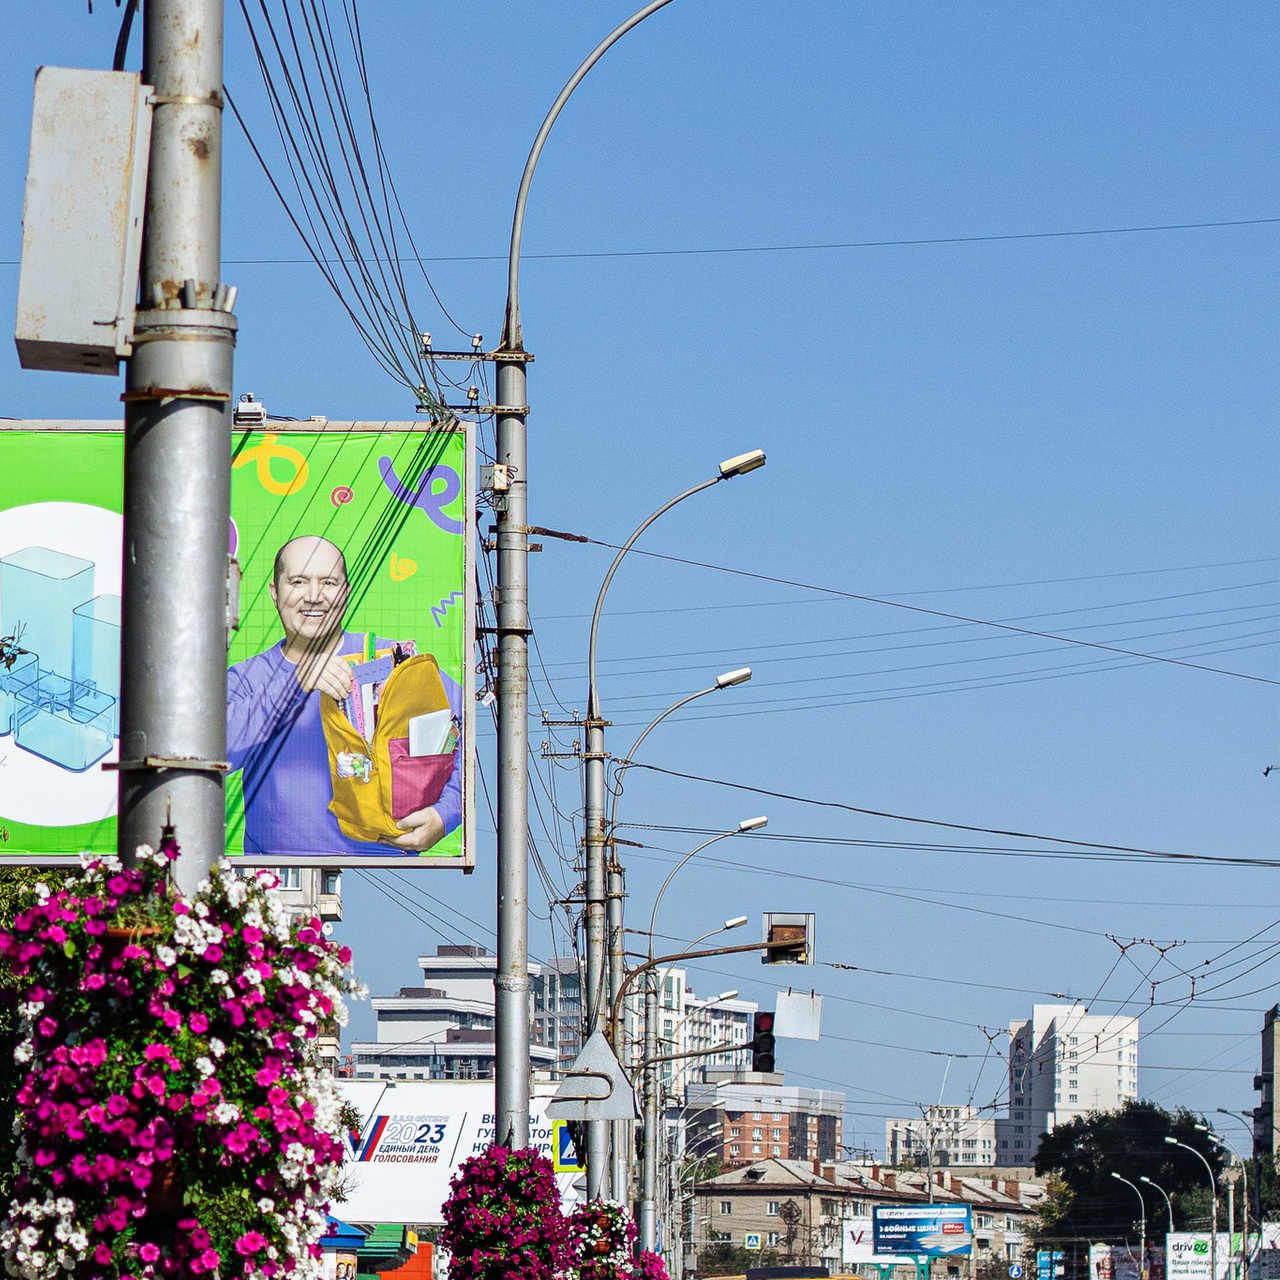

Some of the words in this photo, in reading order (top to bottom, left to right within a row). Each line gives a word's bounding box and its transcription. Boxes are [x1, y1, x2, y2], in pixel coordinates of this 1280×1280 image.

[383, 1122, 447, 1144] 2023
[378, 1144, 416, 1153] ЕДИНЫЙ
[417, 1145, 440, 1154] ДЕНЬ
[373, 1154, 438, 1164] ГОЛОСОВАНИЯ
[1172, 1242, 1209, 1254] drivee
